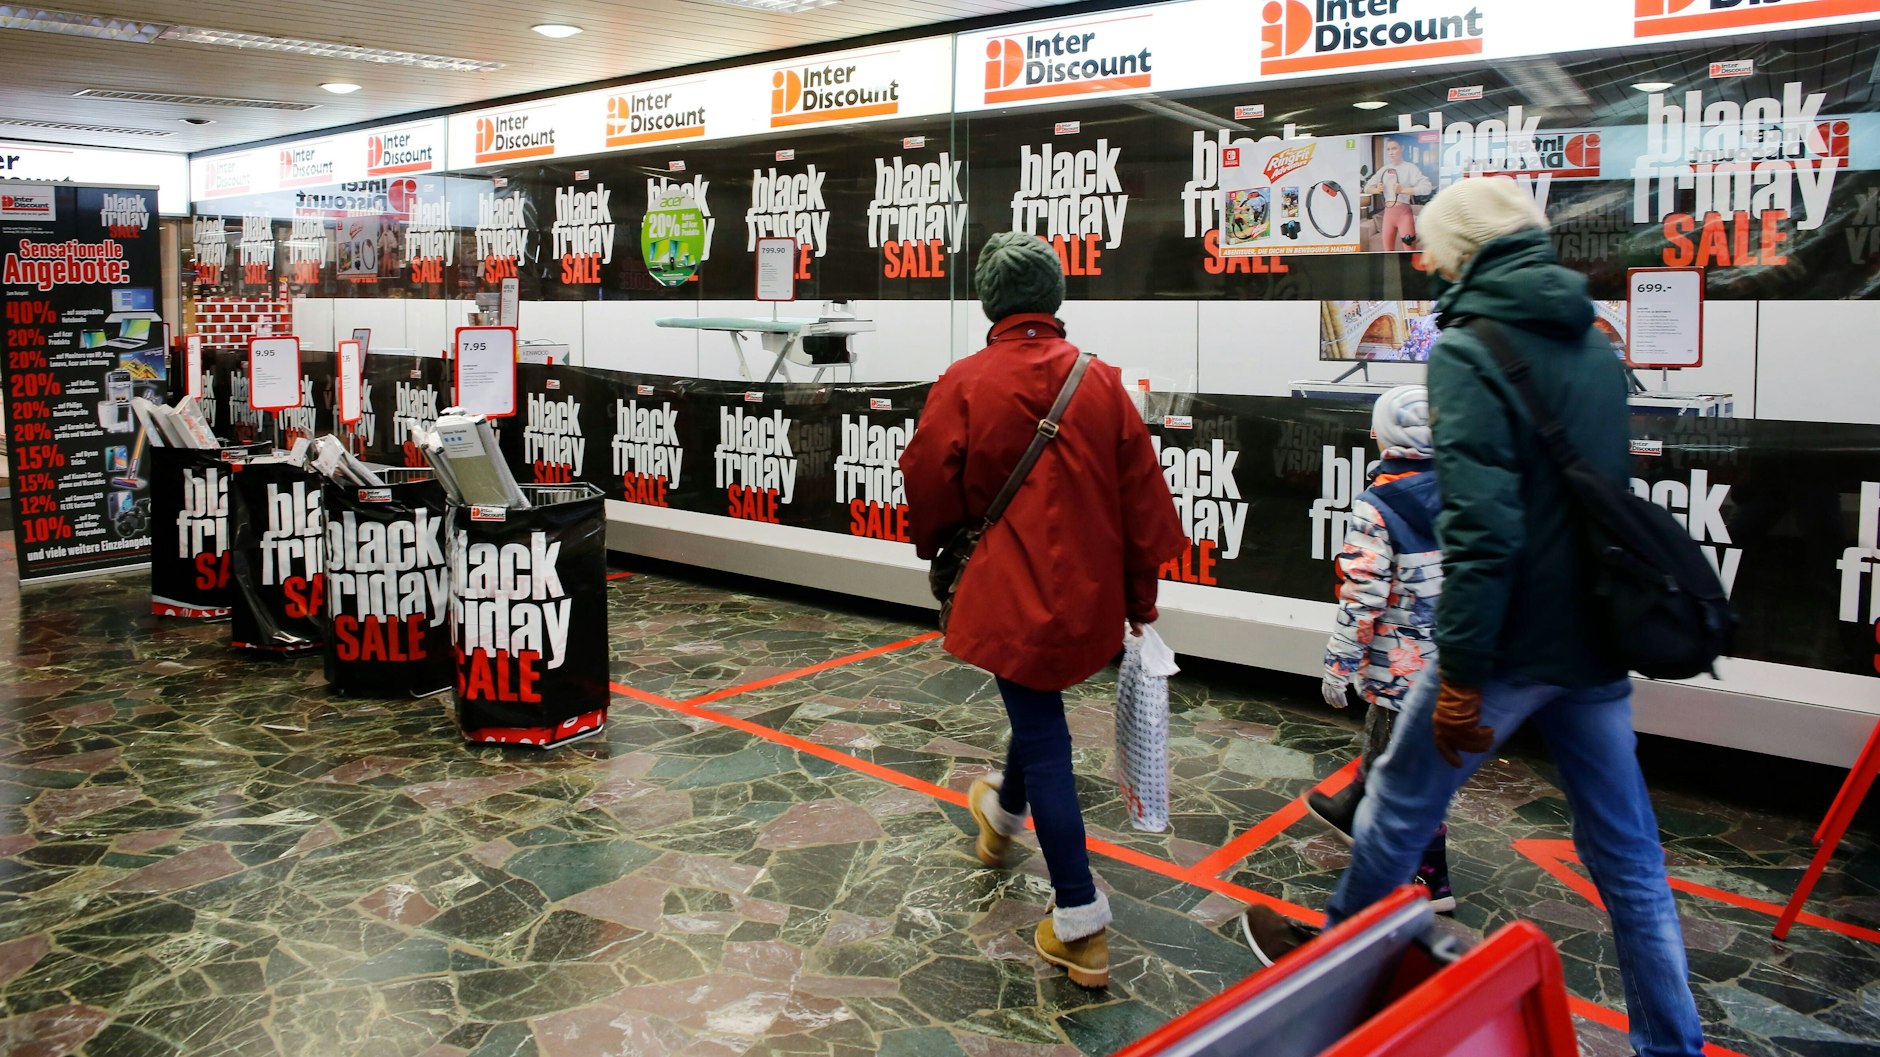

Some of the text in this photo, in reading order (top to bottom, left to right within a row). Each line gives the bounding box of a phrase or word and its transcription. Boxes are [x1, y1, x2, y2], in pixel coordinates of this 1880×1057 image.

[1315, 0, 1411, 24] Inter
[1315, 5, 1484, 53] Discount
[1026, 31, 1095, 60] Inter
[803, 63, 856, 90] Inter
[1026, 46, 1151, 86] Discount
[1721, 66, 1752, 74] Discount
[630, 91, 672, 114] Inter
[802, 79, 899, 111] Discount
[495, 113, 528, 133] Inter
[630, 107, 706, 133] Discount
[1648, 81, 1829, 163] black
[383, 133, 411, 150] Inter
[495, 128, 555, 151] Discount
[292, 150, 315, 163] Inter
[292, 161, 333, 178] Discount
[383, 147, 432, 166] Discount
[1020, 138, 1123, 198] black
[752, 163, 826, 214] black
[874, 152, 962, 206] black
[1630, 154, 1840, 231] friday
[103, 193, 147, 213] black
[409, 195, 452, 231] black
[478, 189, 526, 230] black
[555, 183, 612, 226] black
[660, 196, 685, 208] acer
[100, 208, 149, 230] friday
[108, 224, 140, 239] SALE
[241, 212, 274, 243] black
[291, 210, 326, 240] black
[648, 213, 681, 239] 20%
[745, 206, 830, 257] friday
[867, 200, 968, 254] friday
[1010, 188, 1129, 250] friday
[19, 239, 123, 259] Sensationelle
[240, 237, 275, 270] friday
[289, 235, 328, 268] friday
[405, 227, 455, 266] friday
[475, 226, 529, 266] friday
[551, 220, 616, 265] friday
[1269, 247, 1285, 255] DICH
[1293, 246, 1329, 254] BEWEGUNG
[1329, 245, 1357, 253] HALTEN!
[1662, 209, 1789, 268] SALE
[3, 252, 130, 291] Angebote:
[244, 261, 267, 284] SALE
[294, 259, 320, 284] SALE
[411, 255, 444, 284] SALE
[484, 254, 519, 284] SALE
[561, 252, 601, 284] SALE
[883, 238, 945, 279] SALE
[1637, 283, 1672, 293] 699.-
[6, 300, 57, 324] 40%
[7, 328, 45, 347] 20%
[463, 342, 487, 352] 7.95
[8, 350, 47, 369] 20%
[255, 349, 276, 357] 9.95
[10, 372, 61, 398] 20%
[396, 381, 439, 419] black
[12, 401, 50, 419] 20%
[527, 392, 583, 436] black
[616, 398, 681, 447] black
[13, 423, 52, 442] 20%
[720, 405, 794, 458] black
[15, 444, 65, 471] 15%
[523, 425, 586, 478] friday
[611, 434, 684, 490] friday
[18, 472, 55, 493] 15%
[534, 459, 572, 484] SALE
[713, 444, 798, 505] friday
[833, 455, 909, 511] frida
[623, 470, 669, 508] SALE
[727, 483, 781, 524] SALE
[20, 494, 57, 515] 12%
[21, 515, 72, 544] 10%
[26, 548, 45, 562] und
[45, 545, 67, 559] viele
[67, 542, 101, 556] weitere
[260, 530, 323, 586] fri
[457, 529, 566, 601] lack
[328, 563, 449, 628] riday
[452, 590, 573, 670] riday
